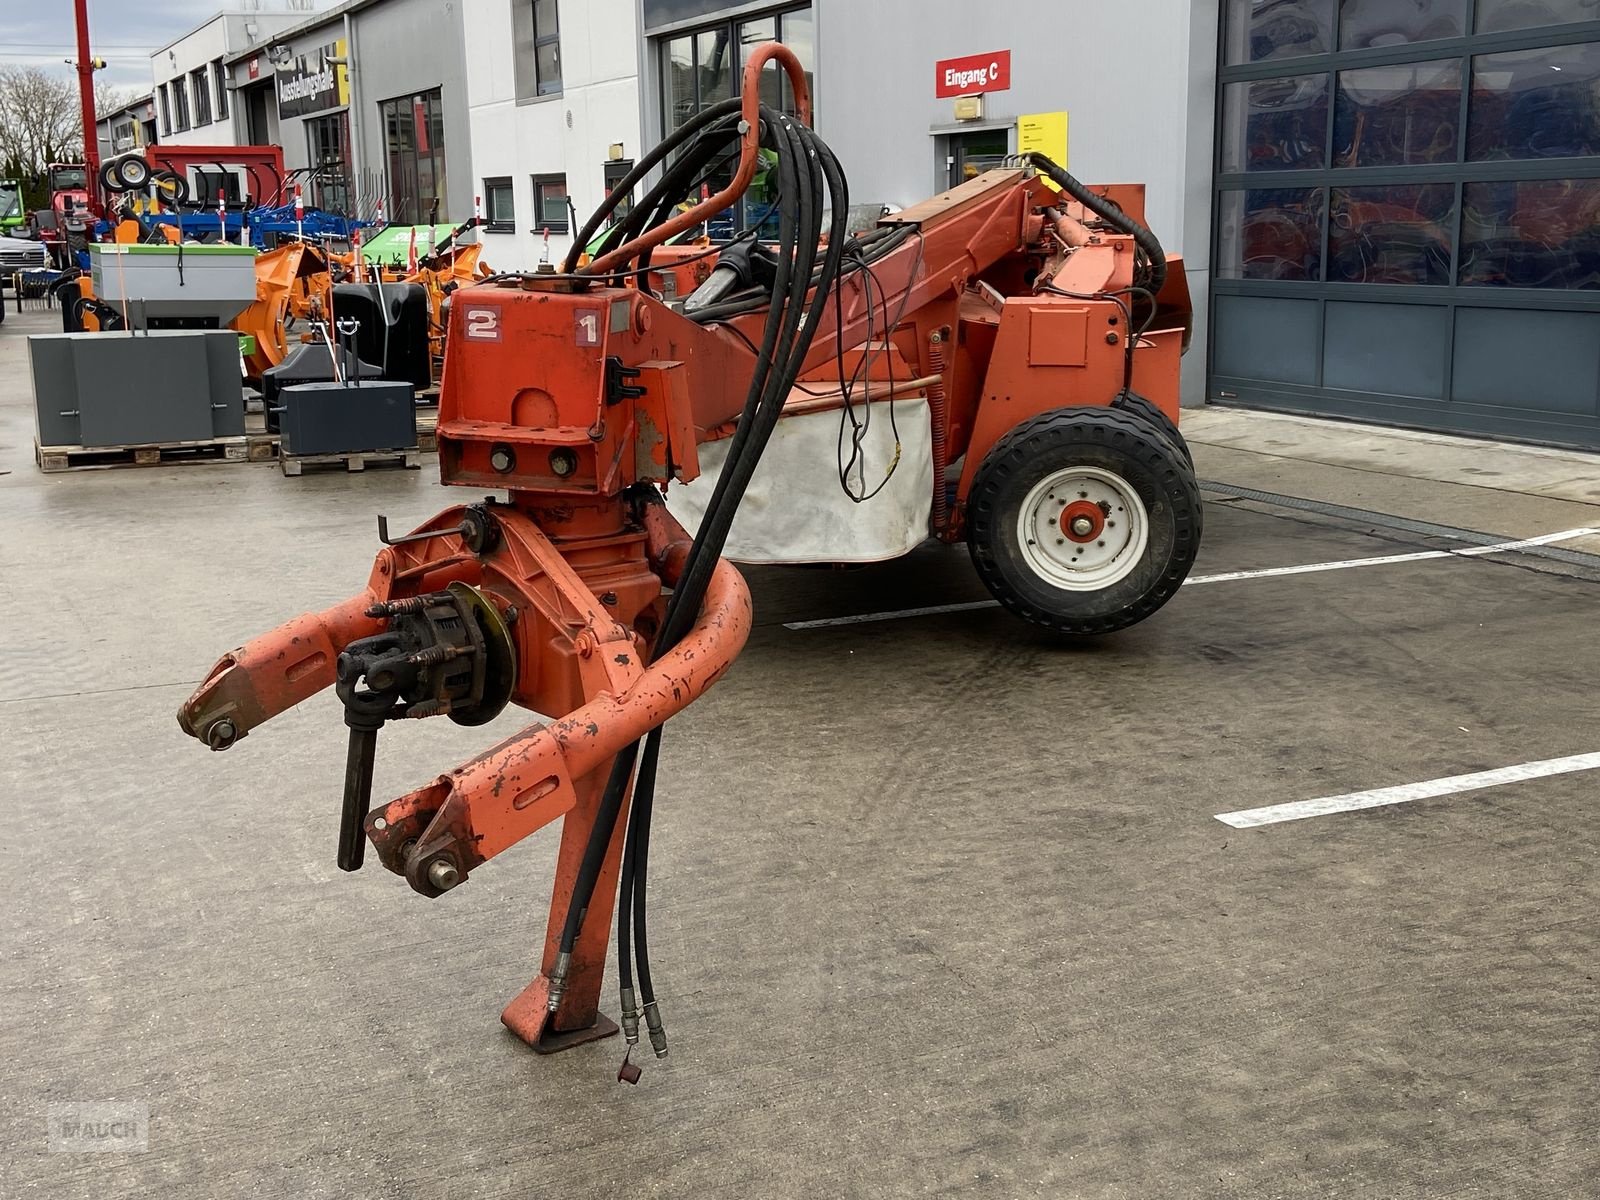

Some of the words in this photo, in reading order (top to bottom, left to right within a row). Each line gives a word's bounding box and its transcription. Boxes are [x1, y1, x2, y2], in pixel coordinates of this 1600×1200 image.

[280, 64, 334, 103] Ausstellungshalle
[945, 67, 987, 88] Eingang
[989, 62, 998, 80] C
[468, 310, 497, 338] 2
[579, 315, 597, 342] 1
